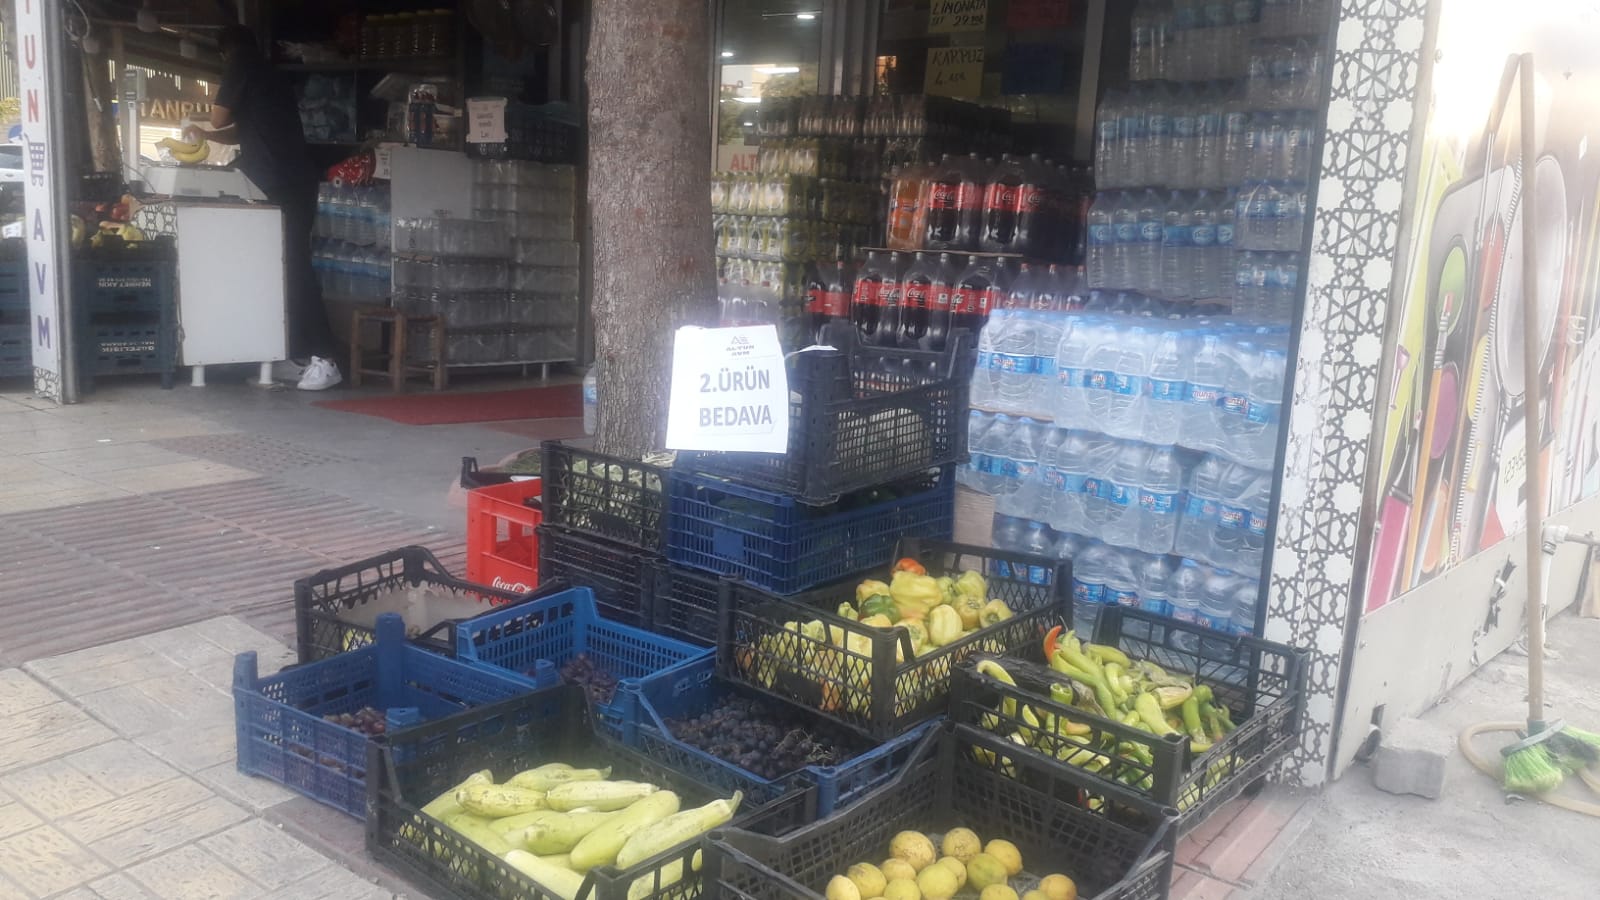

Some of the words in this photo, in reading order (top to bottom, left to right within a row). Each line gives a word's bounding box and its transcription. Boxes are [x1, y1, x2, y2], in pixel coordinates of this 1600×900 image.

[33, 207, 51, 350] AVM
[699, 364, 770, 393] 2.ÜRÜN
[699, 404, 773, 428] BEDAVA
